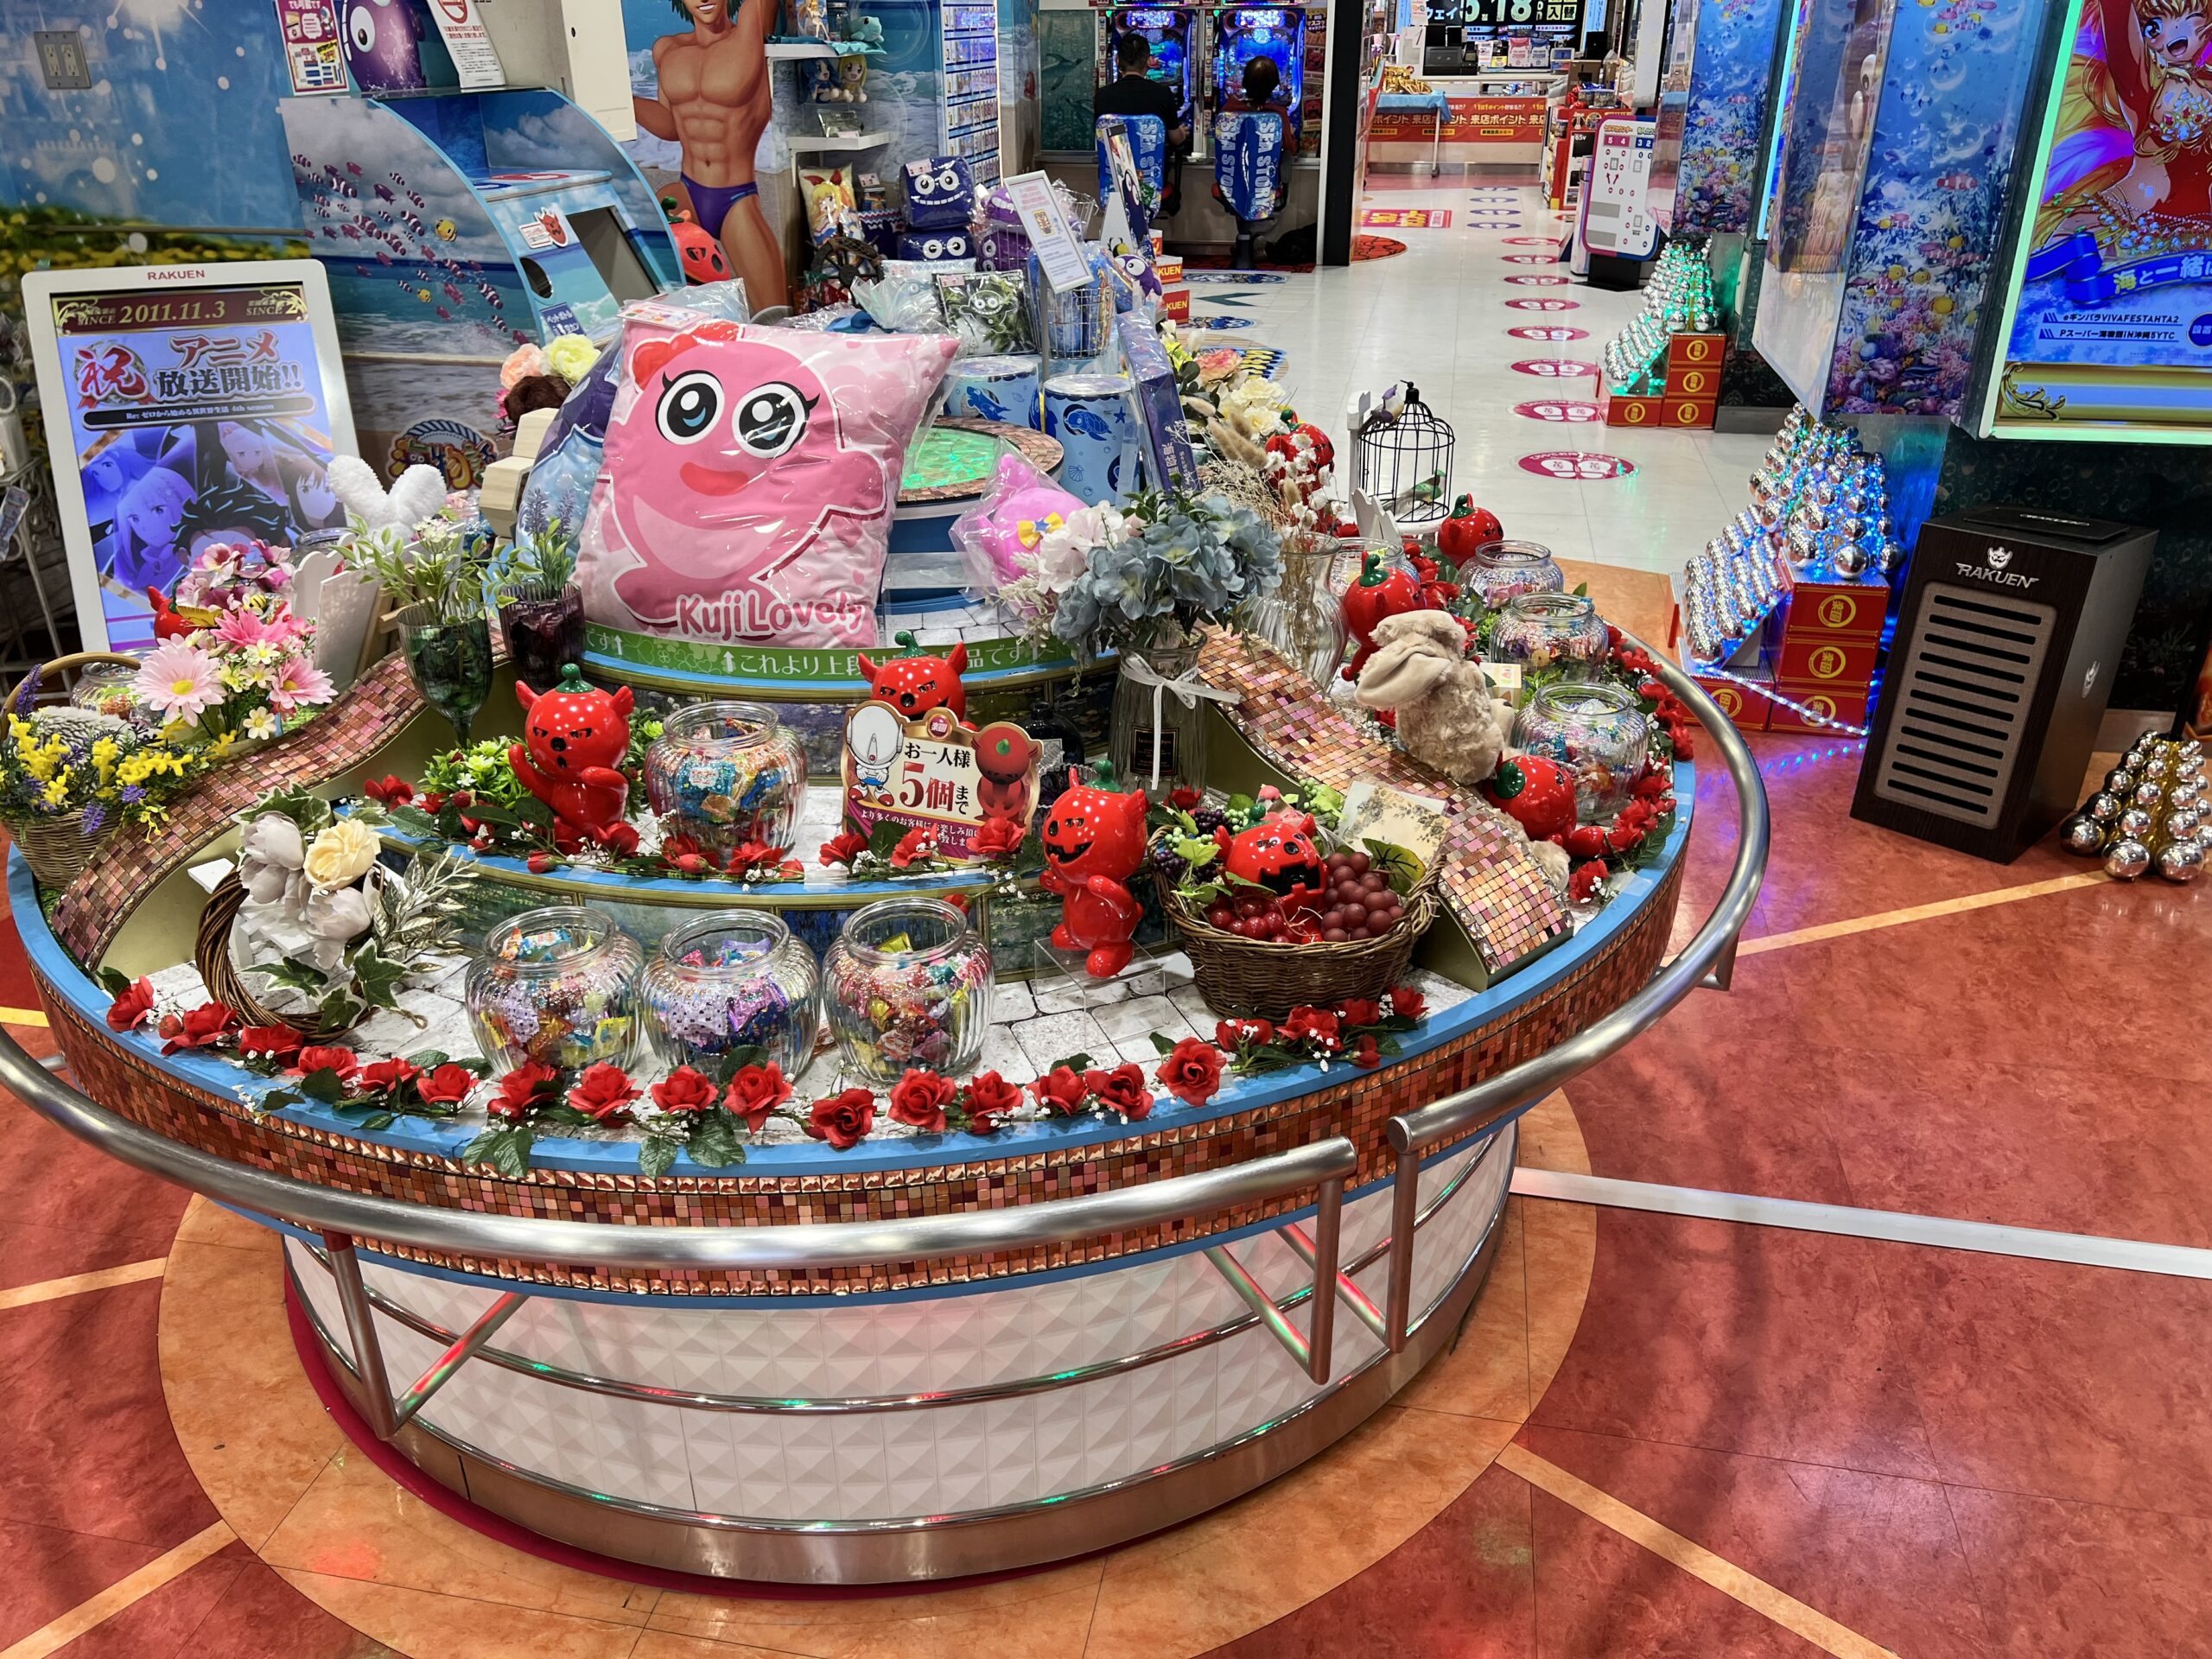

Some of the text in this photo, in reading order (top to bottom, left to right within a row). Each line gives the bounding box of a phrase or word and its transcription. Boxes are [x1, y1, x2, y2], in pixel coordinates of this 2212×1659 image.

[1471, 114, 1527, 124] 来店ポイント
[1255, 121, 1275, 207] SEA STORY
[147, 270, 206, 281] RAKUEN
[1158, 265, 1181, 276] KUEN
[119, 301, 226, 324] 2011.11.3
[172, 332, 277, 367] アニメ
[77, 346, 147, 397] 祝
[156, 364, 302, 397] 放送開始!!
[1956, 563, 2040, 588] RAKUEN
[905, 741, 970, 768] お一人様
